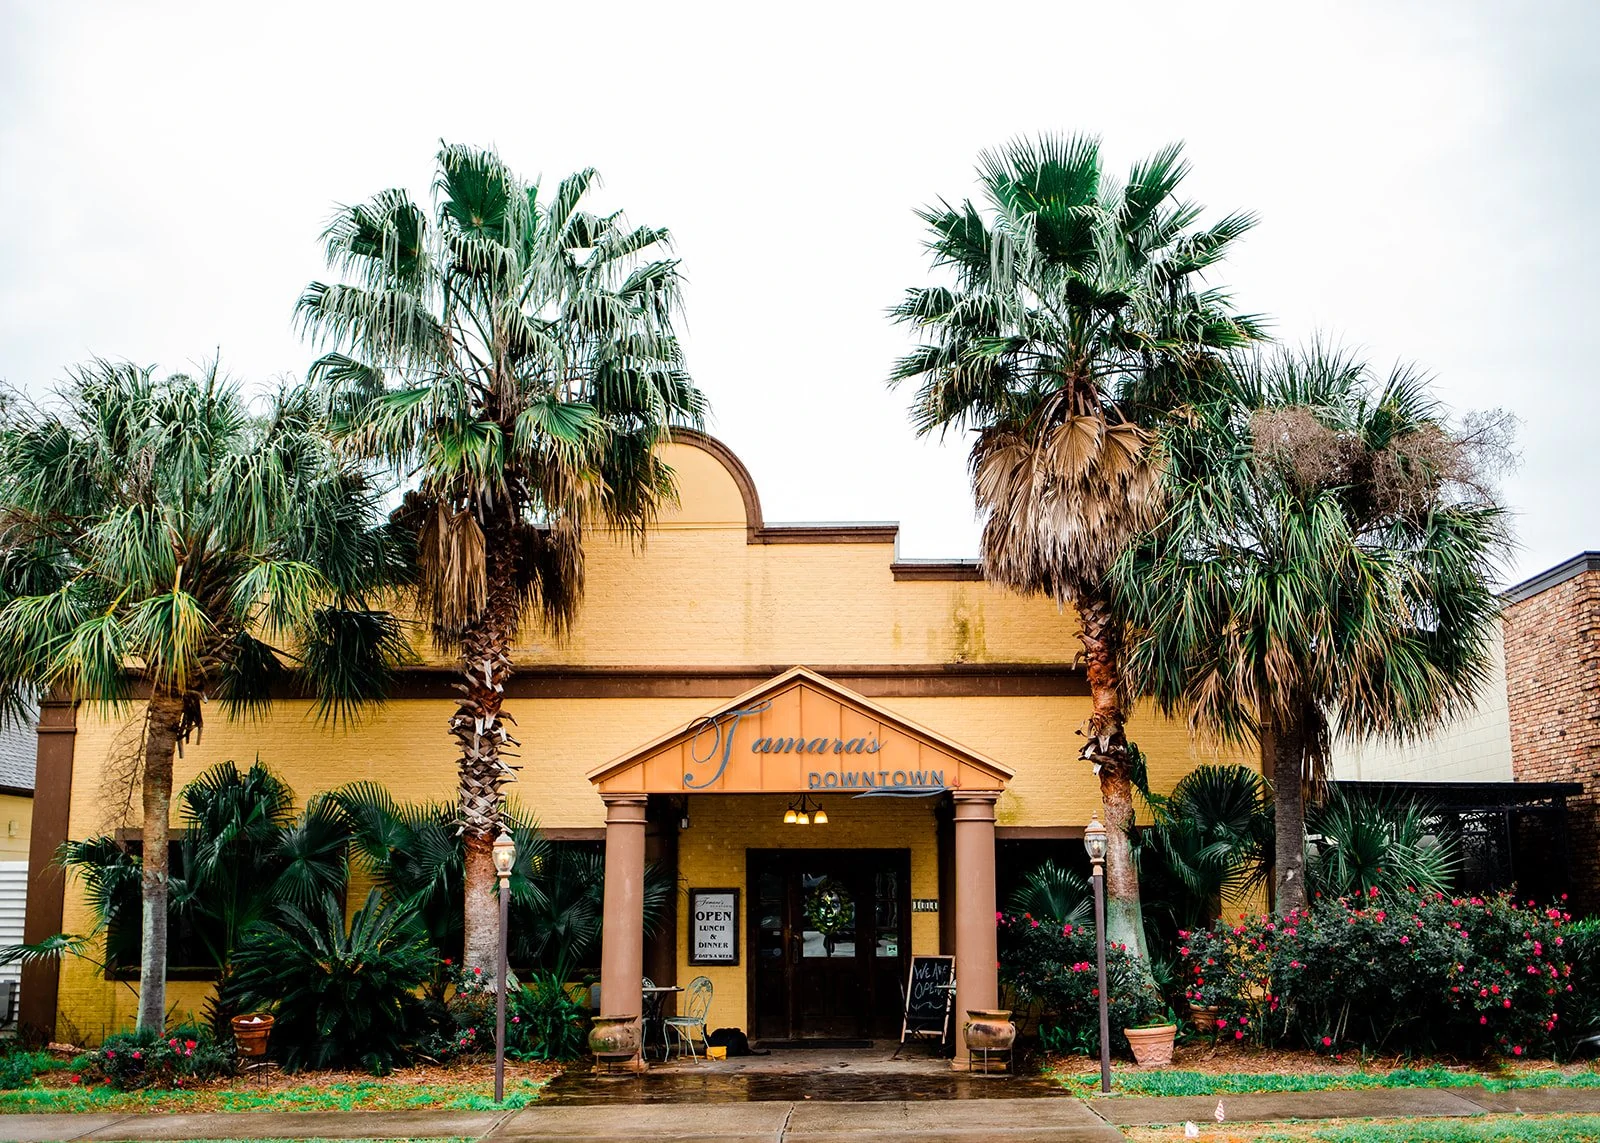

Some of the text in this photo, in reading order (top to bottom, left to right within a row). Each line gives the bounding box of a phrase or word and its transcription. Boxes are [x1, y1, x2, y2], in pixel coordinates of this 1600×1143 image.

[683, 700, 888, 789] Tamara's
[808, 770, 944, 789] DOWNTOWN
[696, 911, 731, 921] OPEN
[914, 962, 931, 980] WE
